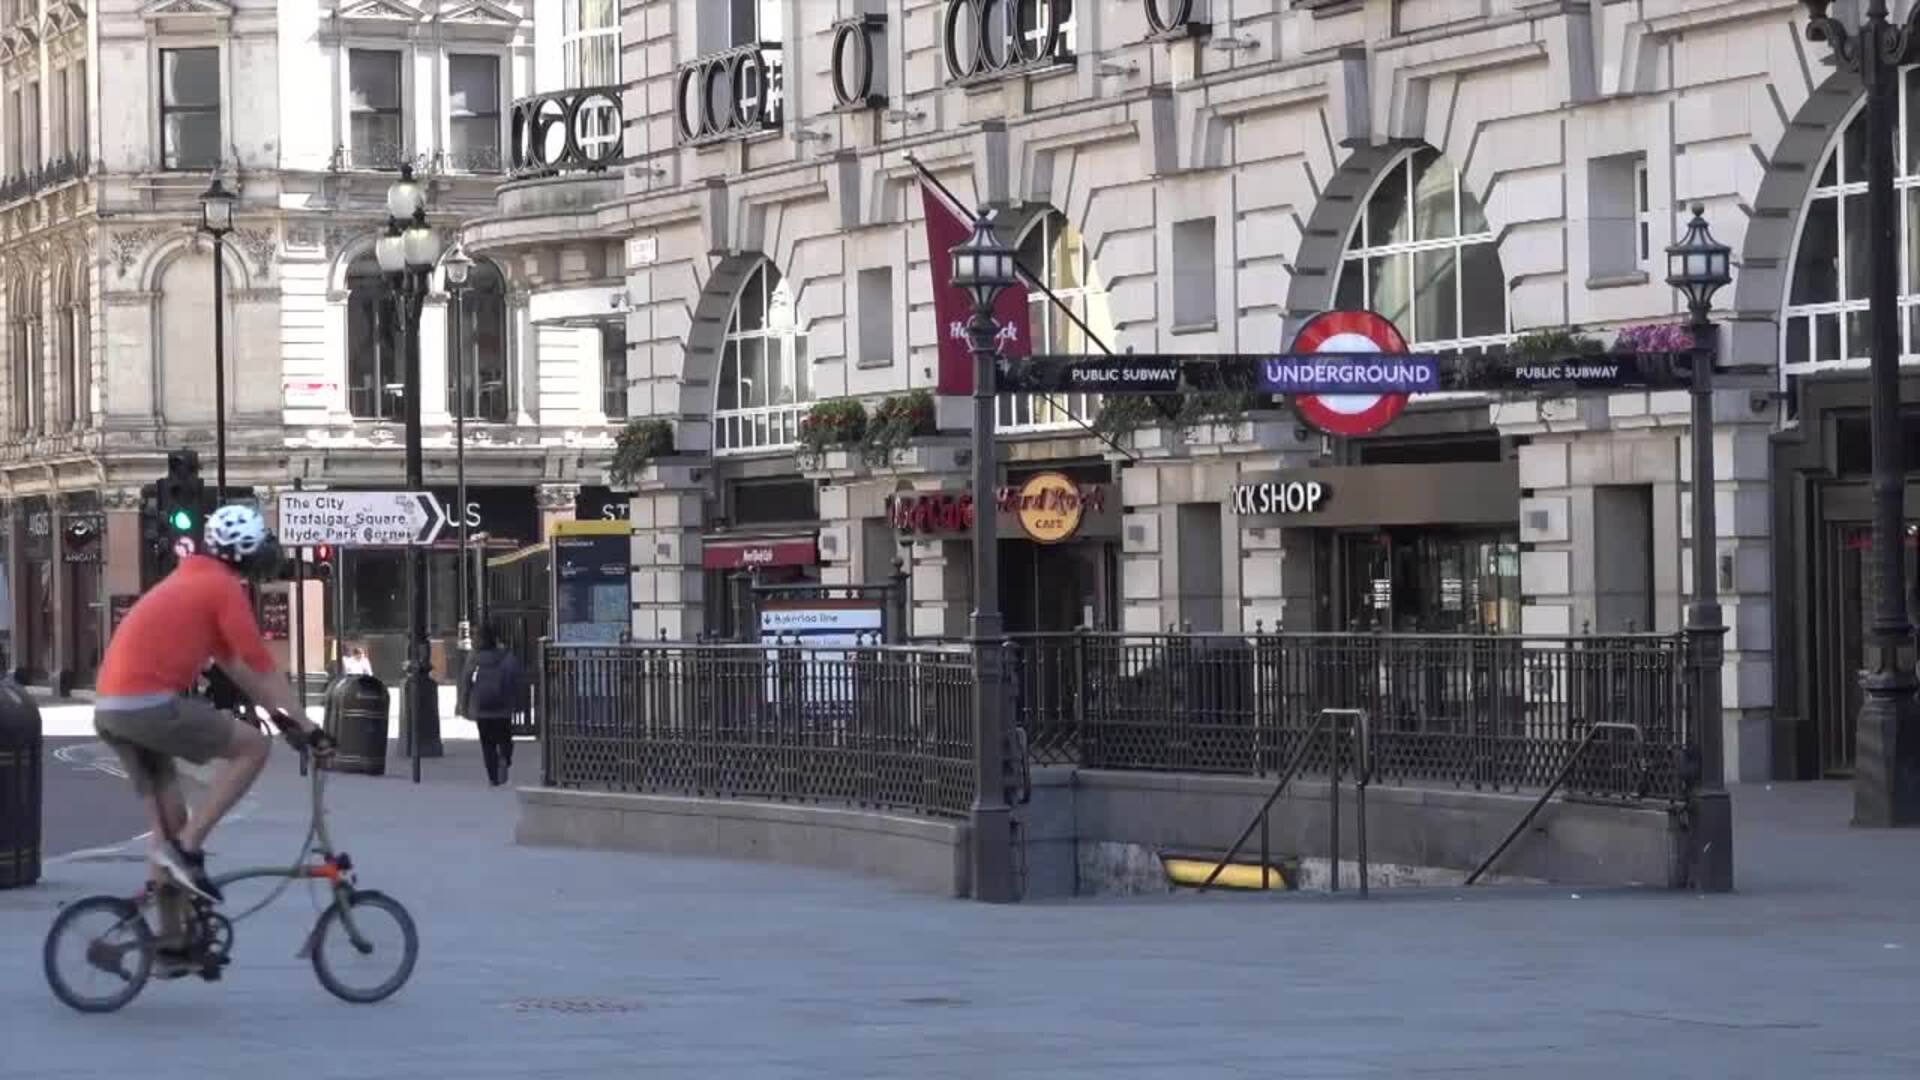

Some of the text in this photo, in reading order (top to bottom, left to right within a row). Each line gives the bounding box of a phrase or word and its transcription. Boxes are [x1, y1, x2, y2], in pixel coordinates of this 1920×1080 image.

[1072, 368, 1177, 381] PUBLIC SUBWAY
[1266, 364, 1430, 383] UNDERGROUND
[1515, 365, 1618, 379] PUBLIC SUBWAY
[285, 497, 345, 511] The City
[1259, 481, 1321, 514] SHOP
[285, 512, 407, 526] Trafalgar Square
[285, 527, 320, 541] Hyde
[326, 527, 357, 540] Park
[819, 613, 838, 623] line
